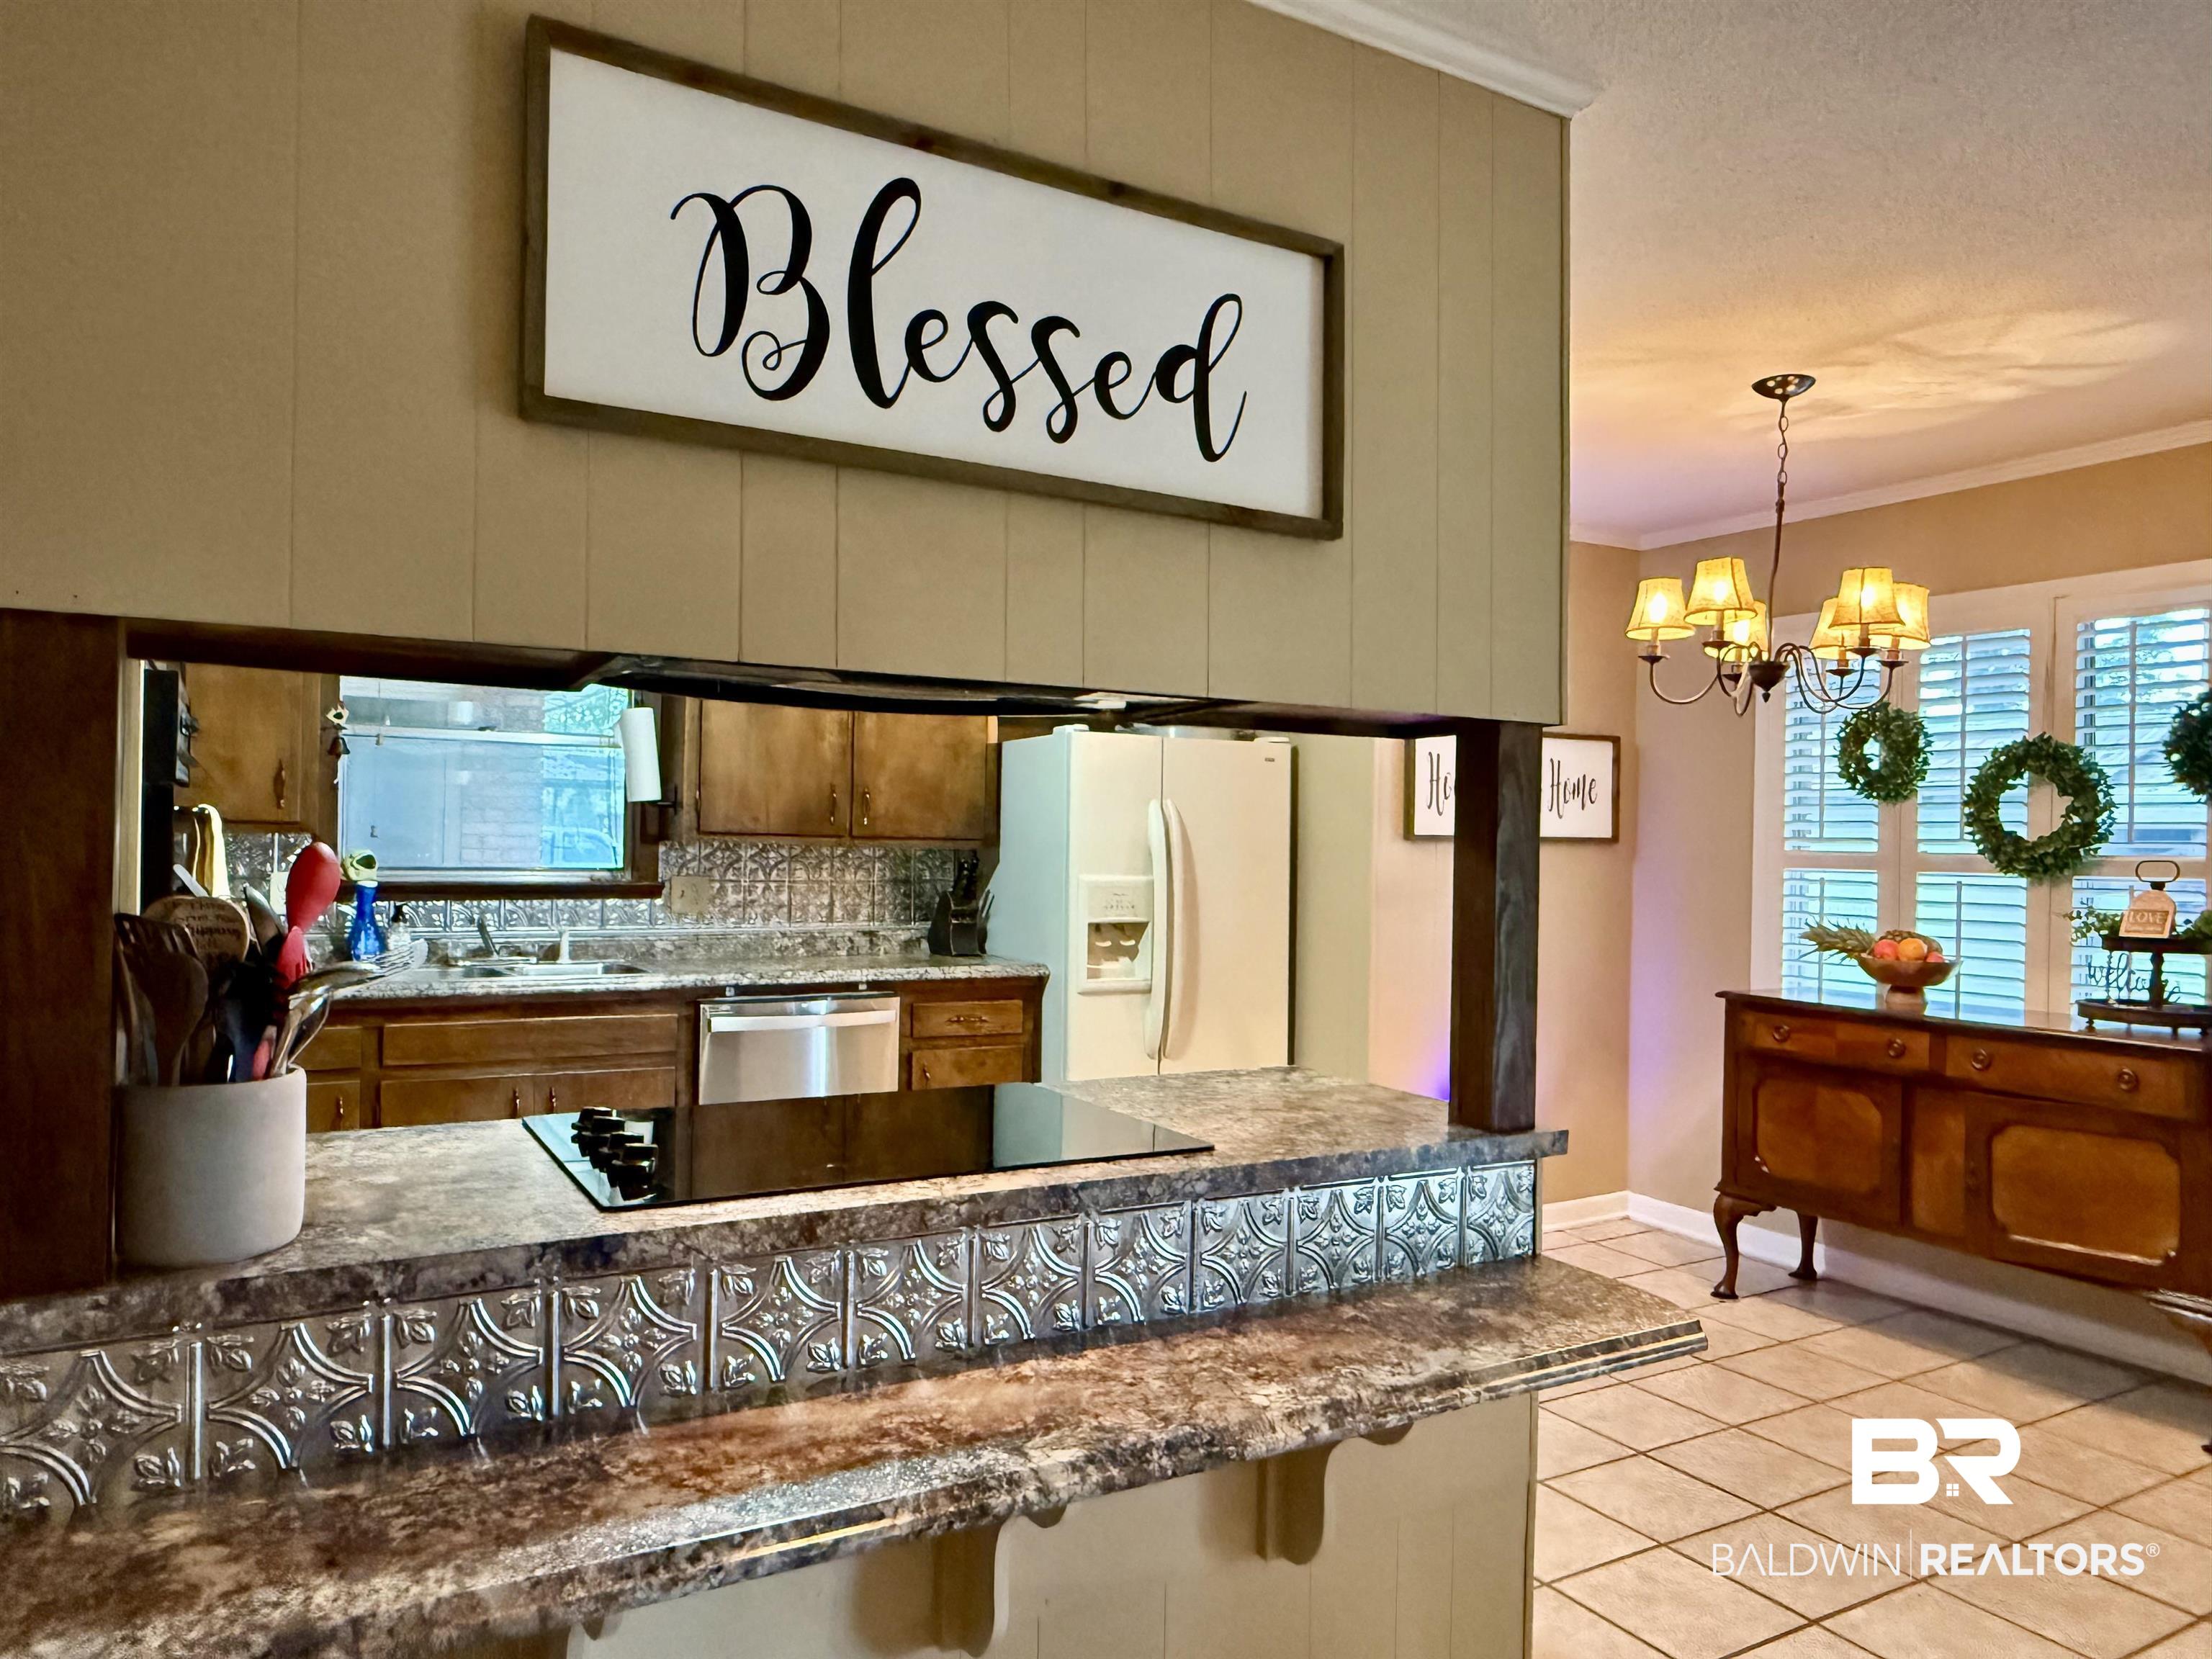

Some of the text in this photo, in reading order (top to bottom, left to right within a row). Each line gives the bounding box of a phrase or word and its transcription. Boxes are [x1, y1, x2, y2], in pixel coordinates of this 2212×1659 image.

[670, 177, 1247, 463] Blessed
[1427, 751, 1599, 819] Ho Home
[2128, 911, 2167, 925] LOVE
[2087, 953, 2181, 1003] welcoe
